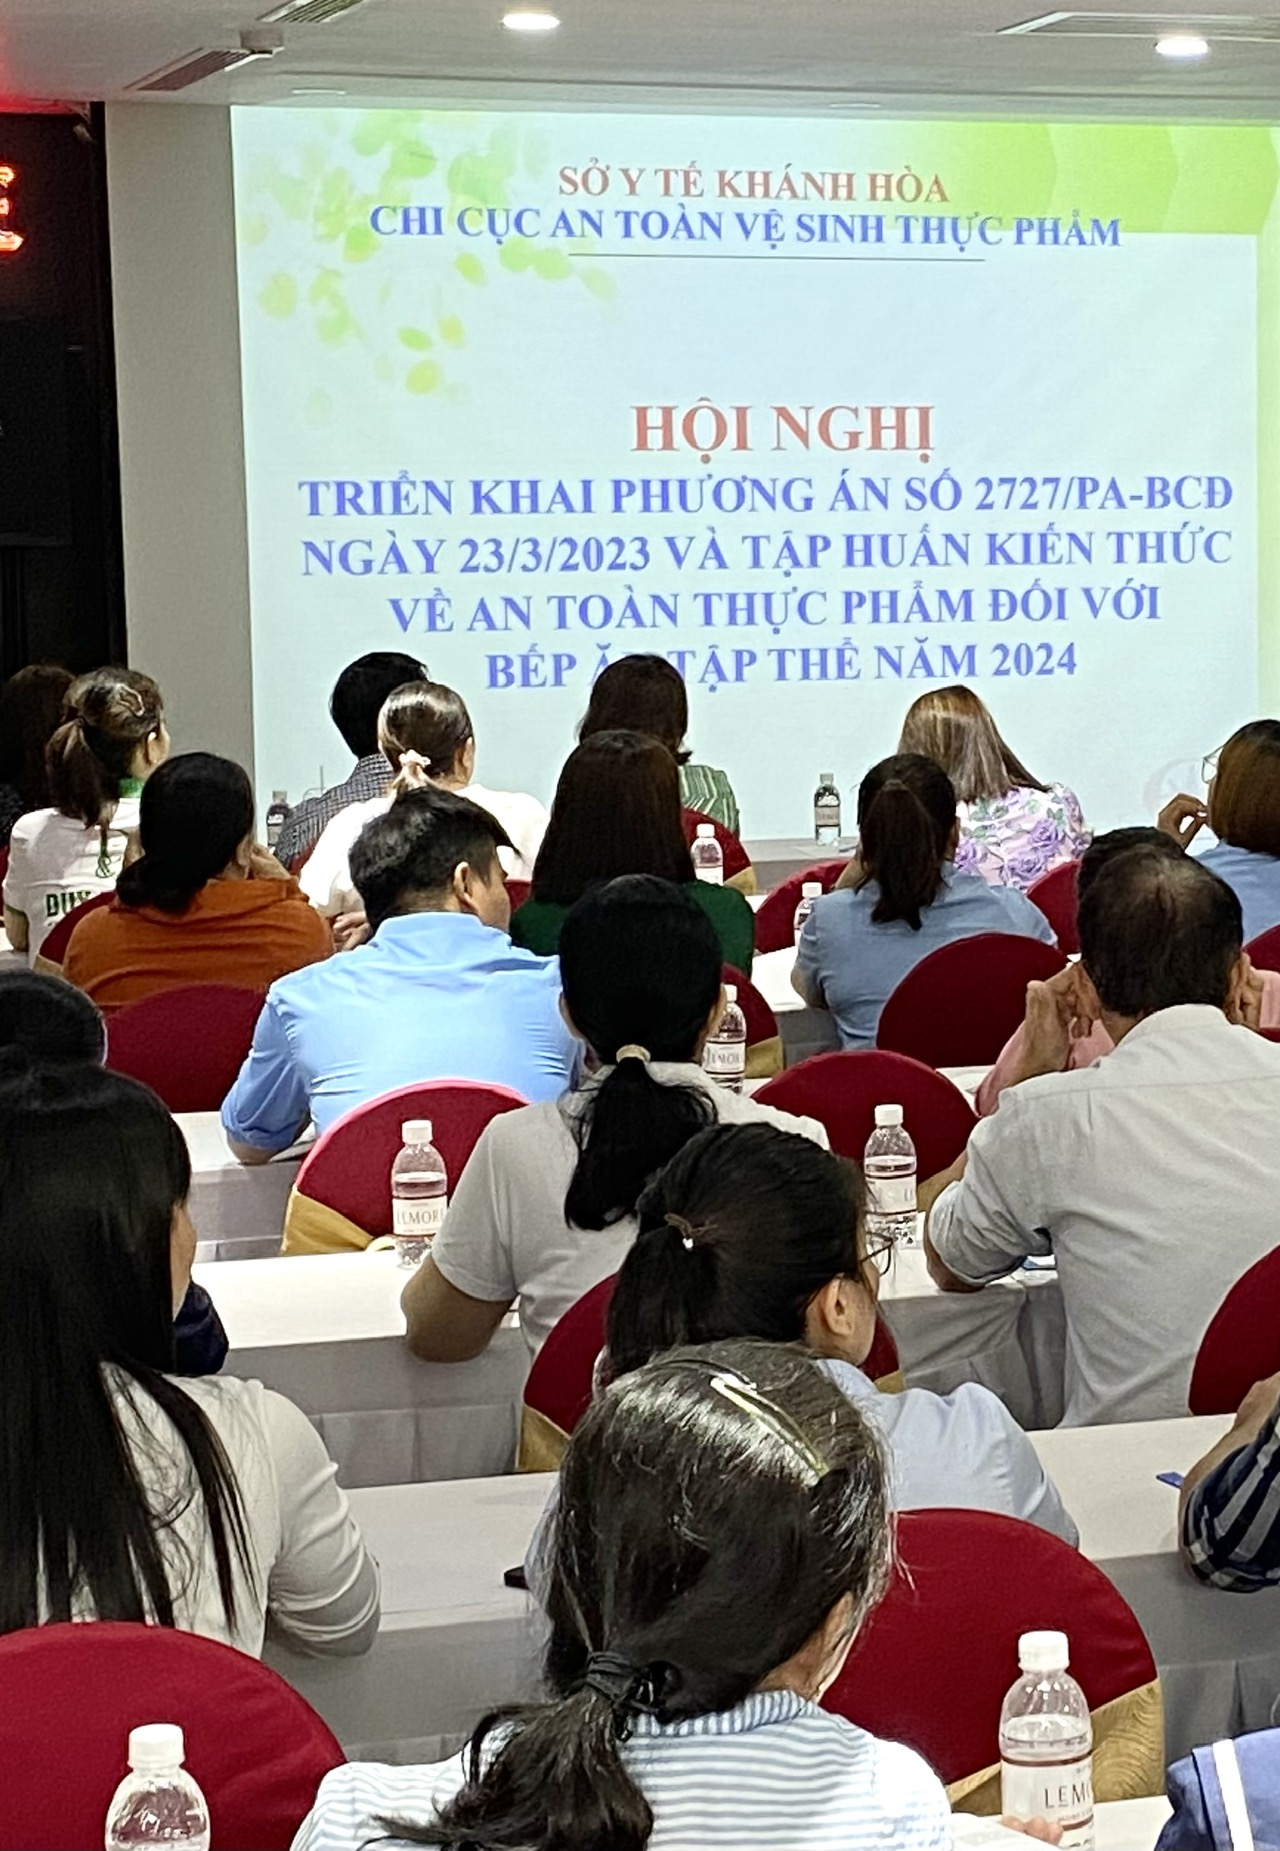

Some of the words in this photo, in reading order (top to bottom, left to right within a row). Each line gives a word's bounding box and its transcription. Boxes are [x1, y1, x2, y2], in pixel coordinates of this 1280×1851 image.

[558, 157, 610, 196] SỞ
[619, 167, 647, 198] Y
[655, 161, 705, 199] TẾ
[717, 162, 856, 202] KHÁNH
[868, 165, 950, 204] HÒA
[370, 204, 444, 237] CHI
[456, 207, 541, 244] CỤC
[550, 208, 605, 240] AN
[614, 203, 724, 243] TOÀN
[734, 208, 786, 251] VỆ
[795, 212, 886, 245] SINH
[894, 212, 1004, 253] THỰC
[1013, 209, 1122, 248] PHẨM
[630, 396, 753, 465] HỘI
[770, 403, 936, 465] NGHỊ
[297, 470, 454, 517] TRIỂN
[468, 478, 595, 516] KHAI
[609, 473, 816, 515] PHƯƠNG
[827, 466, 892, 513] ÁN
[903, 467, 964, 513] SỐ
[974, 474, 1235, 512] 2727/PA-BCĐ
[301, 530, 446, 577] NGÀY
[458, 534, 652, 574] 23/3/2023
[663, 526, 730, 571] VÀ
[741, 529, 833, 578] TẬP
[842, 523, 971, 570] HUẤN
[985, 522, 1094, 567] KIẾN
[1106, 522, 1233, 565] THỨC
[387, 587, 455, 633] VỀ
[466, 594, 533, 633] AN
[546, 584, 680, 632] TOÀN
[692, 587, 828, 635] THỰC
[841, 579, 975, 625] PHẨM
[987, 578, 1068, 623] ĐỐI
[1080, 578, 1163, 622] VỚI
[485, 643, 578, 690] BẾP
[666, 644, 759, 693] TẬP
[767, 636, 863, 683] THỂ
[874, 636, 979, 680] NĂM
[991, 642, 1078, 677] 2024
